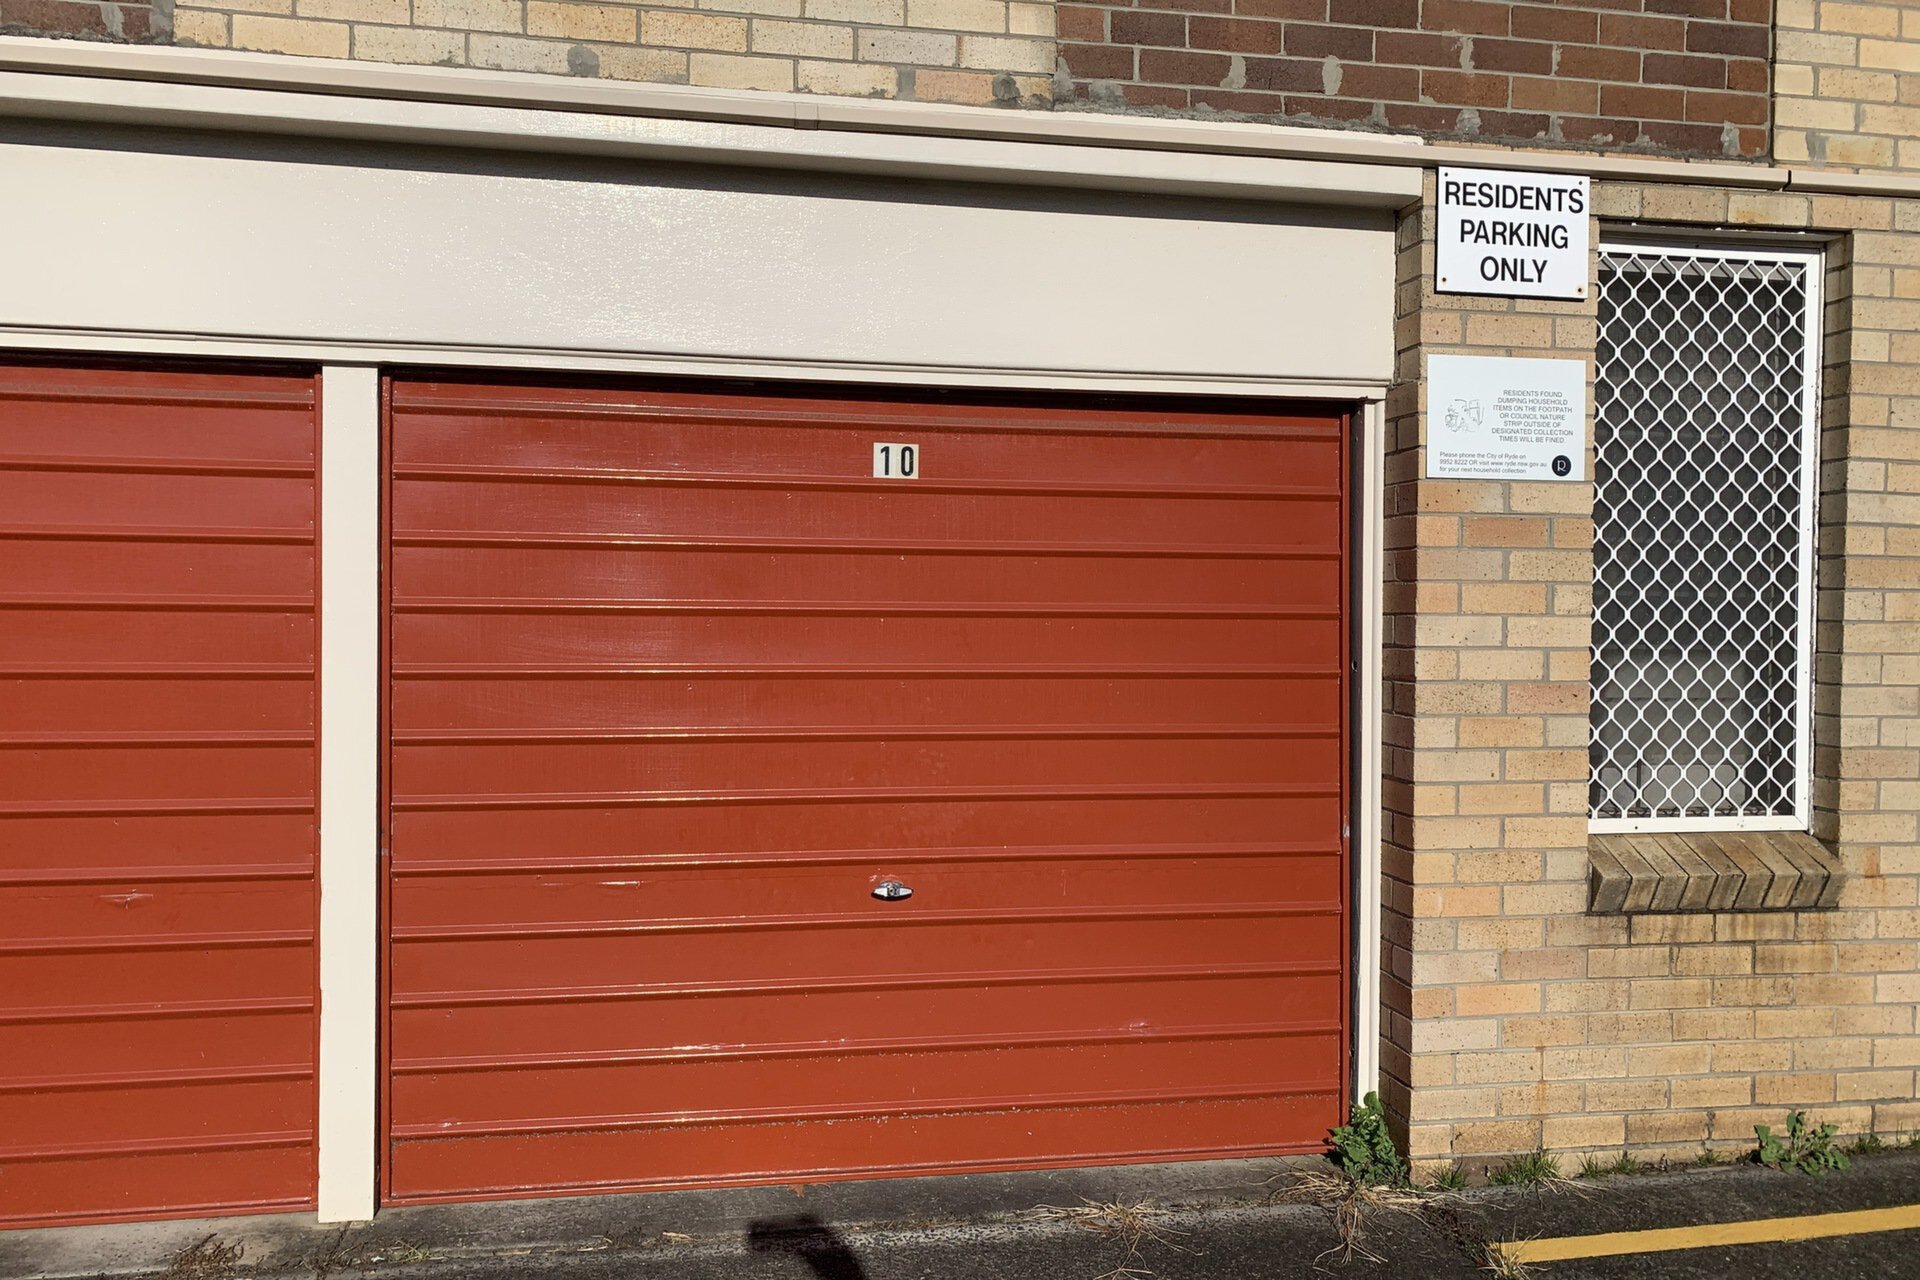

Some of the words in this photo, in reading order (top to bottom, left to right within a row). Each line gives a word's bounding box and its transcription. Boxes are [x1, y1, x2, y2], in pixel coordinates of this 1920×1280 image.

[1444, 181, 1584, 214] RESIDENTS
[1460, 219, 1568, 249] PARKING
[1480, 256, 1548, 283] ONLY
[880, 446, 914, 476] 10
